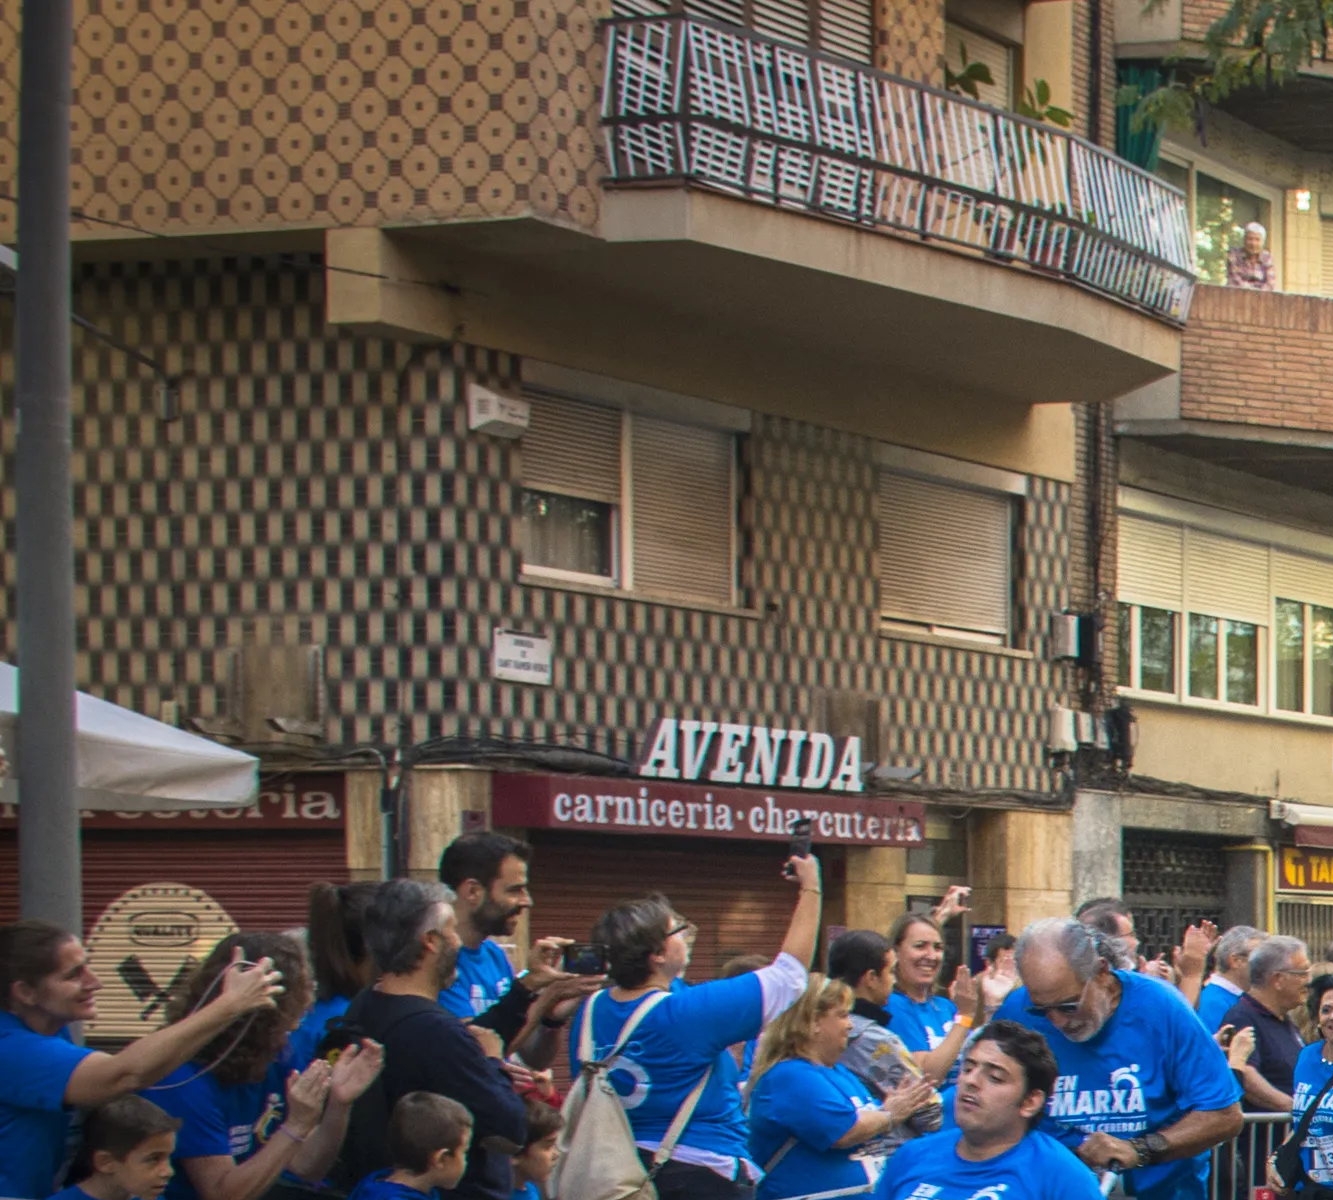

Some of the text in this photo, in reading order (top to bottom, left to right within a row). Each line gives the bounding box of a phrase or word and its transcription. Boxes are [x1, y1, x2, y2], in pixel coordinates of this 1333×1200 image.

[639, 717, 864, 793] AVENIDA
[552, 786, 735, 832] carniceria
[1053, 1075, 1079, 1092] EN
[1296, 1082, 1312, 1094] EN
[1047, 1088, 1147, 1117] MARXA
[911, 1182, 943, 1197] EN
